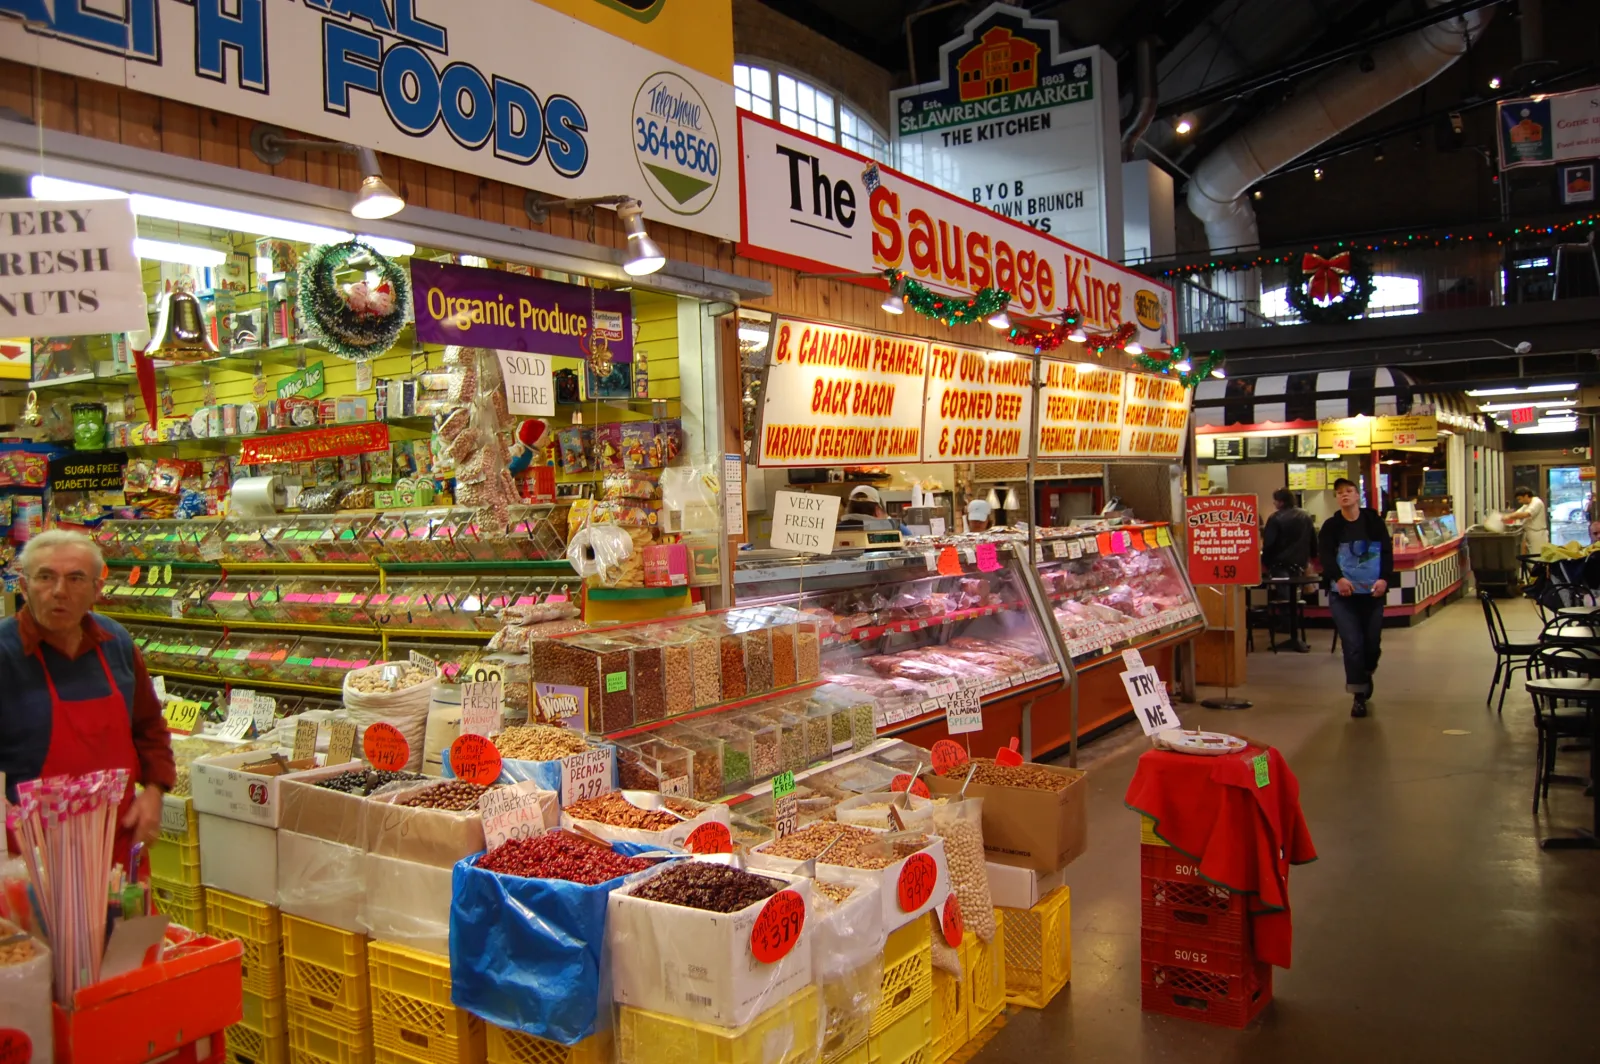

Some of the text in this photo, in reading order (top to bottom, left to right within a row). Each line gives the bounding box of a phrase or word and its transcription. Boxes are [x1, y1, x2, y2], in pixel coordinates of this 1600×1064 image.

[1041, 73, 1065, 86] 1803
[321, 16, 588, 179] FOODS
[647, 81, 702, 130] Telephone
[918, 98, 1010, 129] LAWRENCE
[1014, 81, 1089, 111] MARKET
[923, 100, 942, 112] Est.
[941, 112, 1051, 147] THE KITCHEN
[1556, 118, 1588, 130] Come
[983, 191, 1084, 218] OWN BRUNCH
[0, 208, 92, 237] ERY
[776, 144, 1123, 330] The Sausage King
[0, 288, 100, 318] NUTS
[427, 286, 588, 338] Organic Produce
[798, 328, 872, 370] CANADIAN
[873, 337, 925, 376] PEAMEAL
[506, 356, 546, 377] SOLD
[931, 348, 1031, 387] TRY OUR FAMOUS
[511, 384, 549, 406] HERE
[811, 378, 896, 417] BACK BACON
[940, 389, 1022, 421] CORNED BEEF
[1511, 406, 1534, 425] EXIT
[765, 425, 919, 459] VARIOUS SELECTIONS OF SALAMI
[938, 427, 1021, 456] & SIDE BACON
[64, 463, 120, 476] SUGAR FREE
[54, 478, 99, 490] DIABETIC
[788, 495, 825, 512] VERY
[1230, 499, 1254, 513] KING
[784, 513, 826, 531] FRESH
[1188, 510, 1256, 528] SPECIAL
[784, 531, 820, 548] NUTS
[1193, 527, 1250, 538] Pork Backs
[1193, 538, 1213, 546] rolled
[1192, 544, 1237, 555] Peameal
[1213, 565, 1237, 579] 4.59
[464, 681, 498, 697] VERY
[947, 688, 977, 701] VERY
[1129, 672, 1156, 697] TRY
[463, 697, 498, 710] FRESH
[540, 696, 578, 720] WONKA
[947, 697, 980, 709] FRESH
[948, 706, 981, 717] ALMONDS
[169, 704, 197, 723] 1.99
[949, 716, 981, 727] SPECIAL
[1144, 704, 1168, 728] ME
[460, 735, 488, 749] SPECIAL
[562, 749, 611, 770] VERY FRESH
[570, 762, 605, 783] PECANS
[773, 771, 792, 786] VERY
[482, 785, 518, 809] DRIED
[774, 780, 796, 799] FRESH
[484, 807, 540, 835] SPECIAL
[693, 822, 720, 841] SPECIAL
[901, 862, 934, 887] TODAY
[763, 892, 790, 920] SPECIAL
